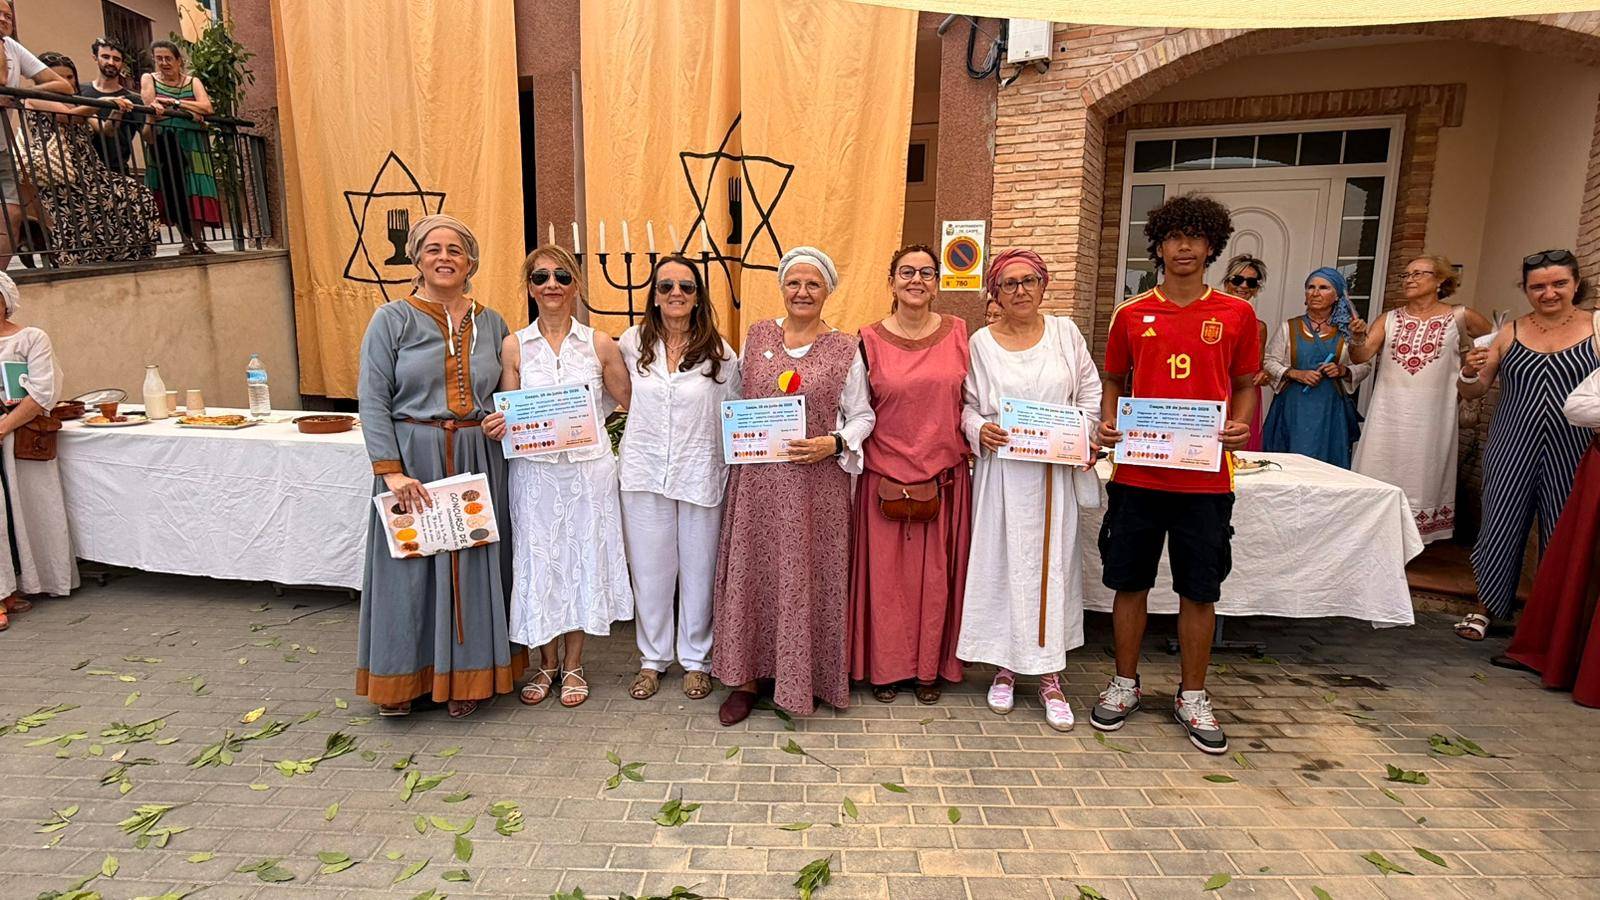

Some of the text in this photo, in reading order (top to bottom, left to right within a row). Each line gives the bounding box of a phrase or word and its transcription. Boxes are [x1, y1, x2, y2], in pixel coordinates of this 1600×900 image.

[1167, 353, 1191, 379] 19
[449, 492, 464, 532] CONCURSO
[458, 533, 467, 544] DE
